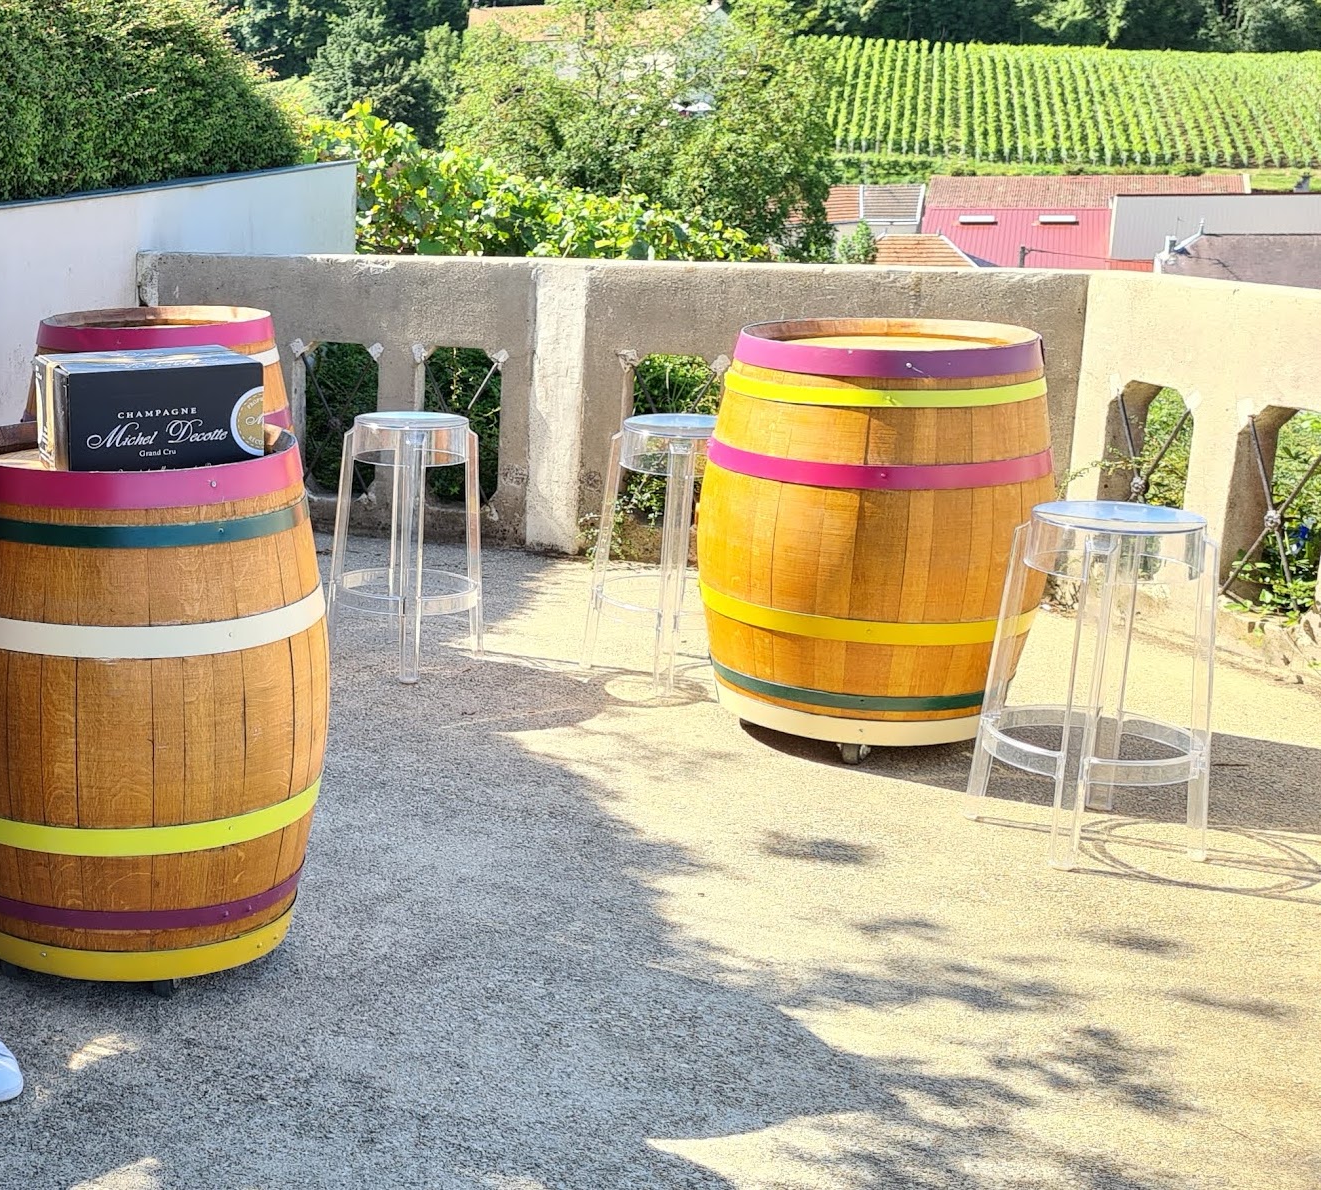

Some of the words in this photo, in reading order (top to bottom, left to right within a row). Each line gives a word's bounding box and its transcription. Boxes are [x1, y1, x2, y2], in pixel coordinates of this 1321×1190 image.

[117, 407, 197, 419] CHAMPAGNE
[86, 421, 159, 449] Michel
[165, 419, 228, 444] Decotte
[139, 449, 161, 457] Grand
[163, 448, 176, 456] Cru
